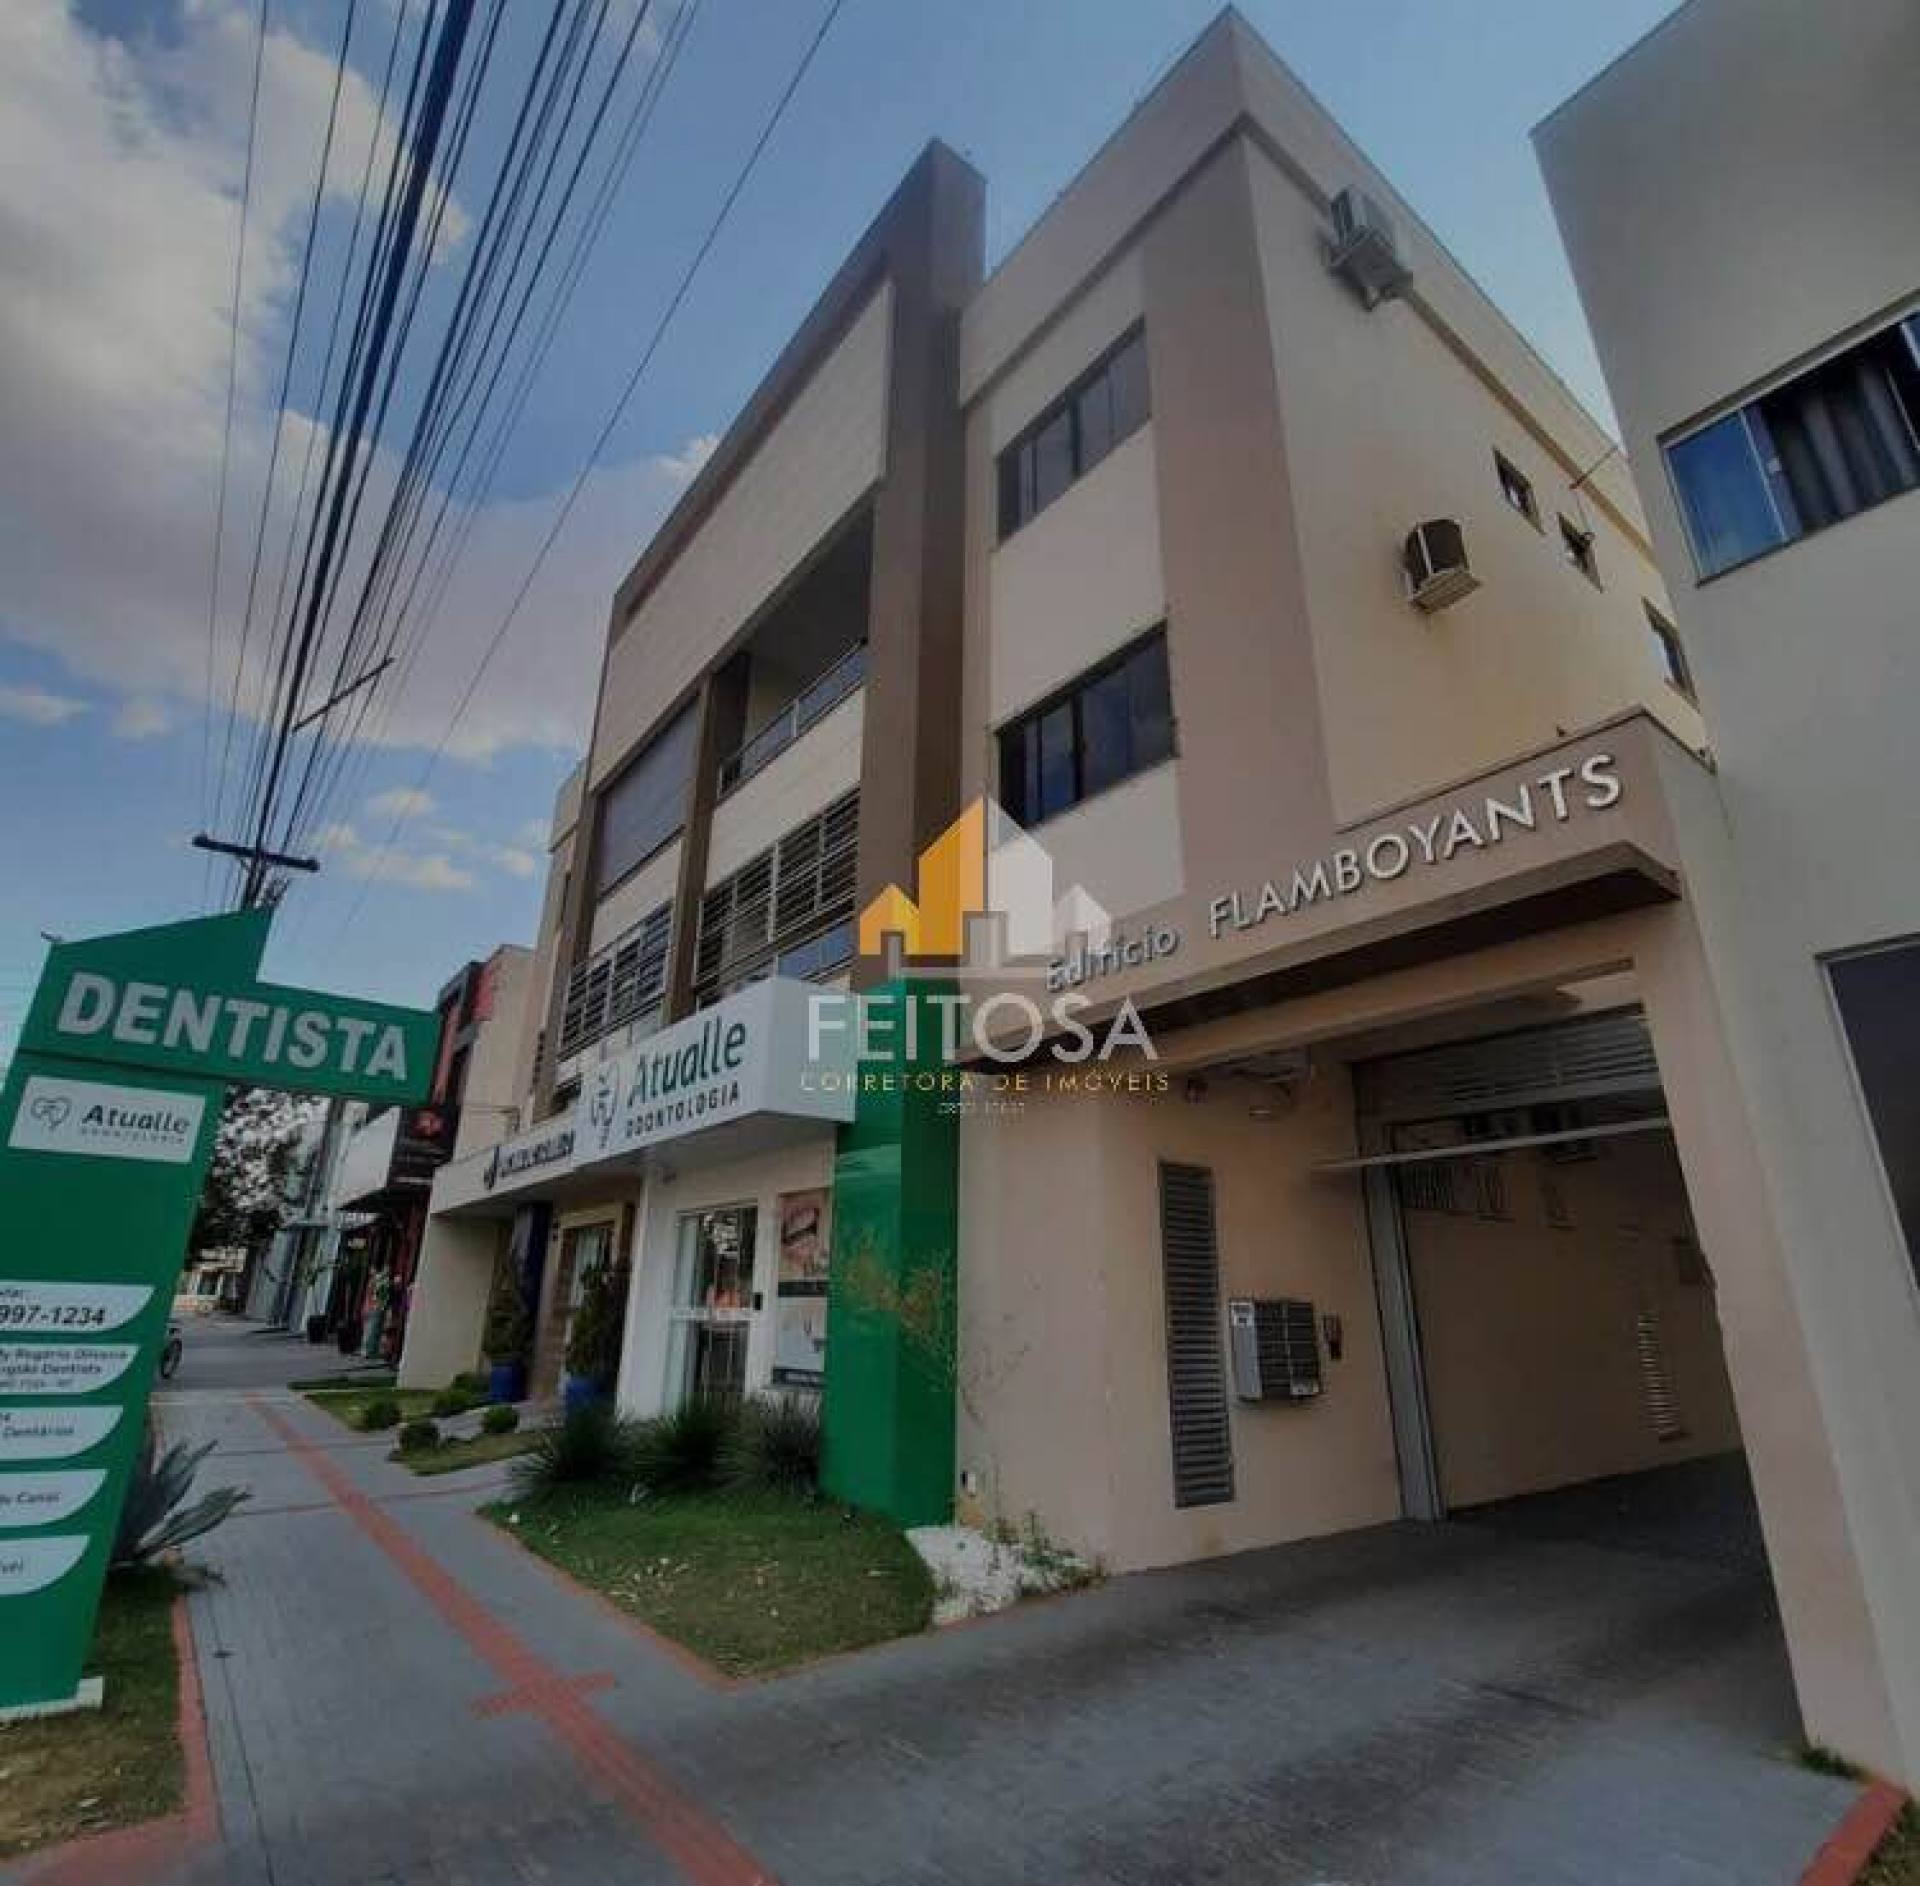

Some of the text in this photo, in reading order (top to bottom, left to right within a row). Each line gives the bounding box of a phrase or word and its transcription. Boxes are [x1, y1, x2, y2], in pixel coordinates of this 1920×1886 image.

[1209, 754, 1622, 937] FLAMBOYANTS
[57, 972, 408, 1081] DENTISTA
[626, 1016, 746, 1107] Atualle
[82, 1105, 190, 1135] Atualle
[626, 1080, 740, 1138] ODONTOLOGIA
